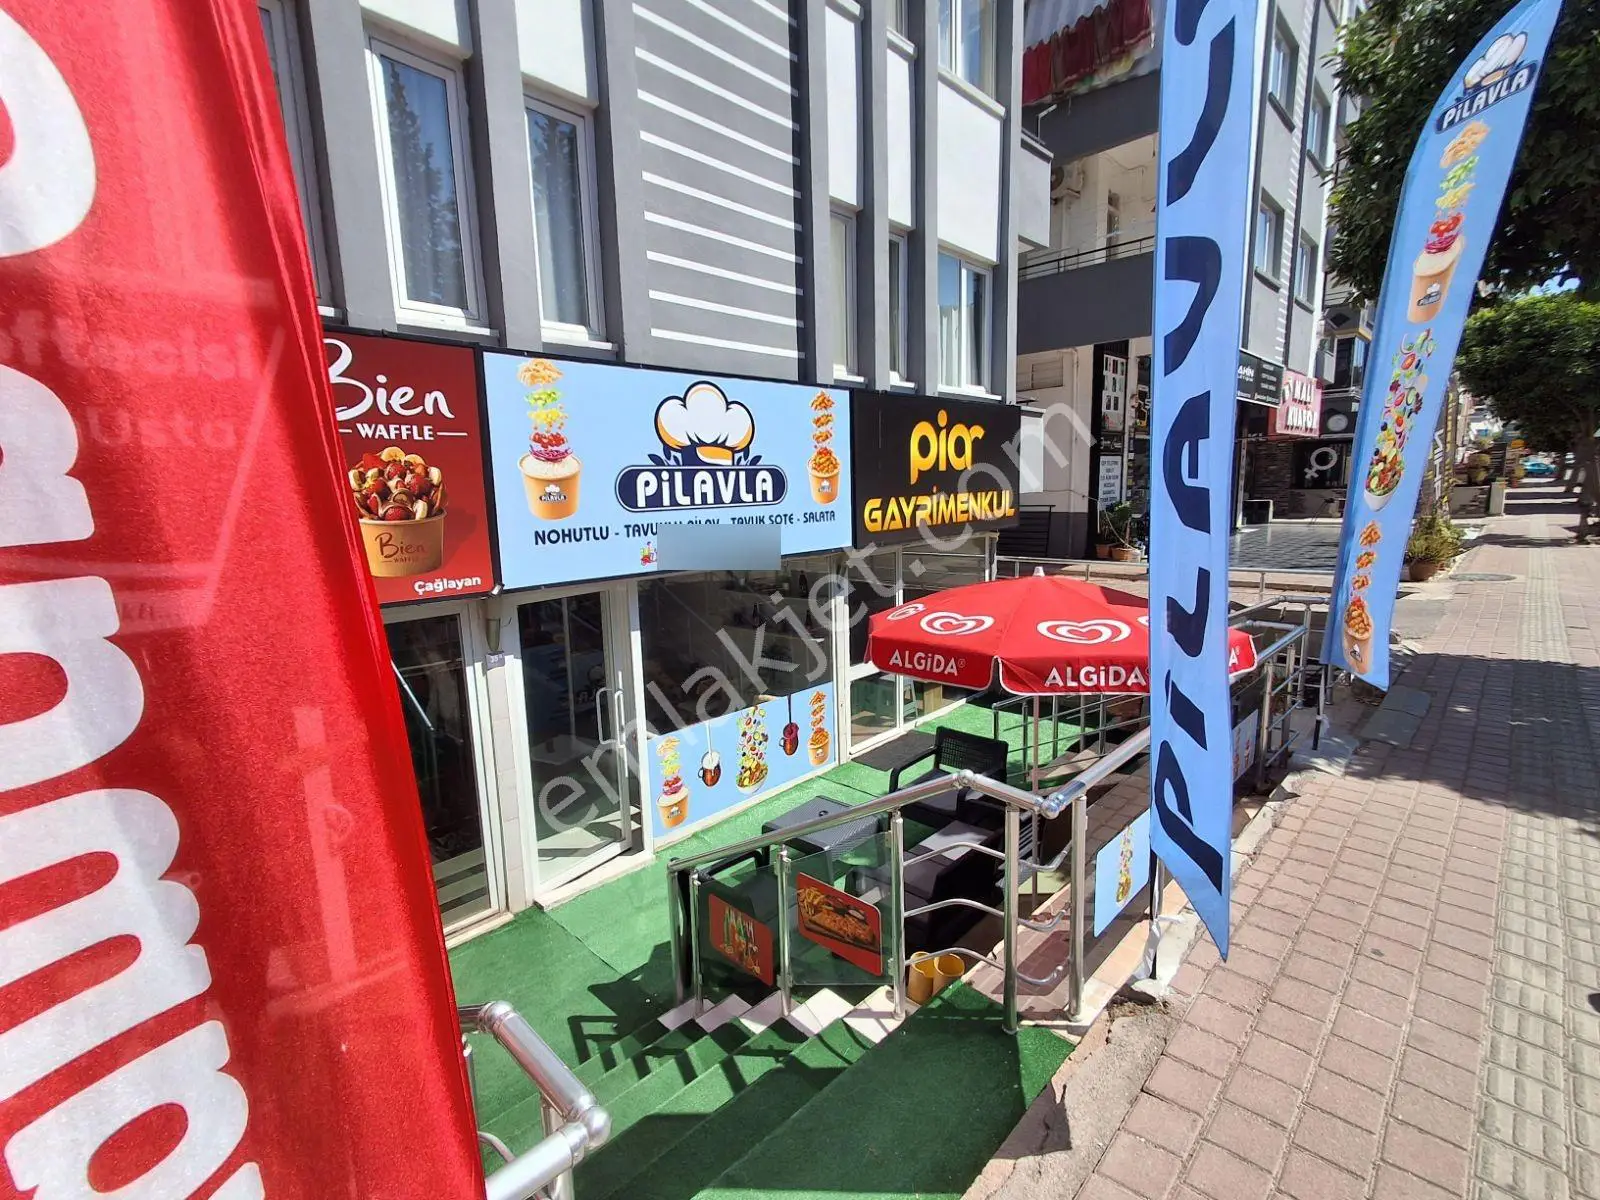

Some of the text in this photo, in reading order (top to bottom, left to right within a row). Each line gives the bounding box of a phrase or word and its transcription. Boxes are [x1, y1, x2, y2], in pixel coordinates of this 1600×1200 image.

[322, 337, 456, 421] Bien
[355, 422, 435, 441] WAFFLE
[909, 408, 985, 485] piar
[1154, 0, 1236, 897] PiLAVL
[534, 525, 609, 545] NOHUTLU
[625, 521, 680, 539] TAVU
[769, 513, 794, 525] SOTE
[803, 510, 835, 523] SALATA
[863, 484, 1016, 532] GAYRİMENKUL
[374, 531, 427, 558] Bien
[413, 574, 481, 595] Çağlayan
